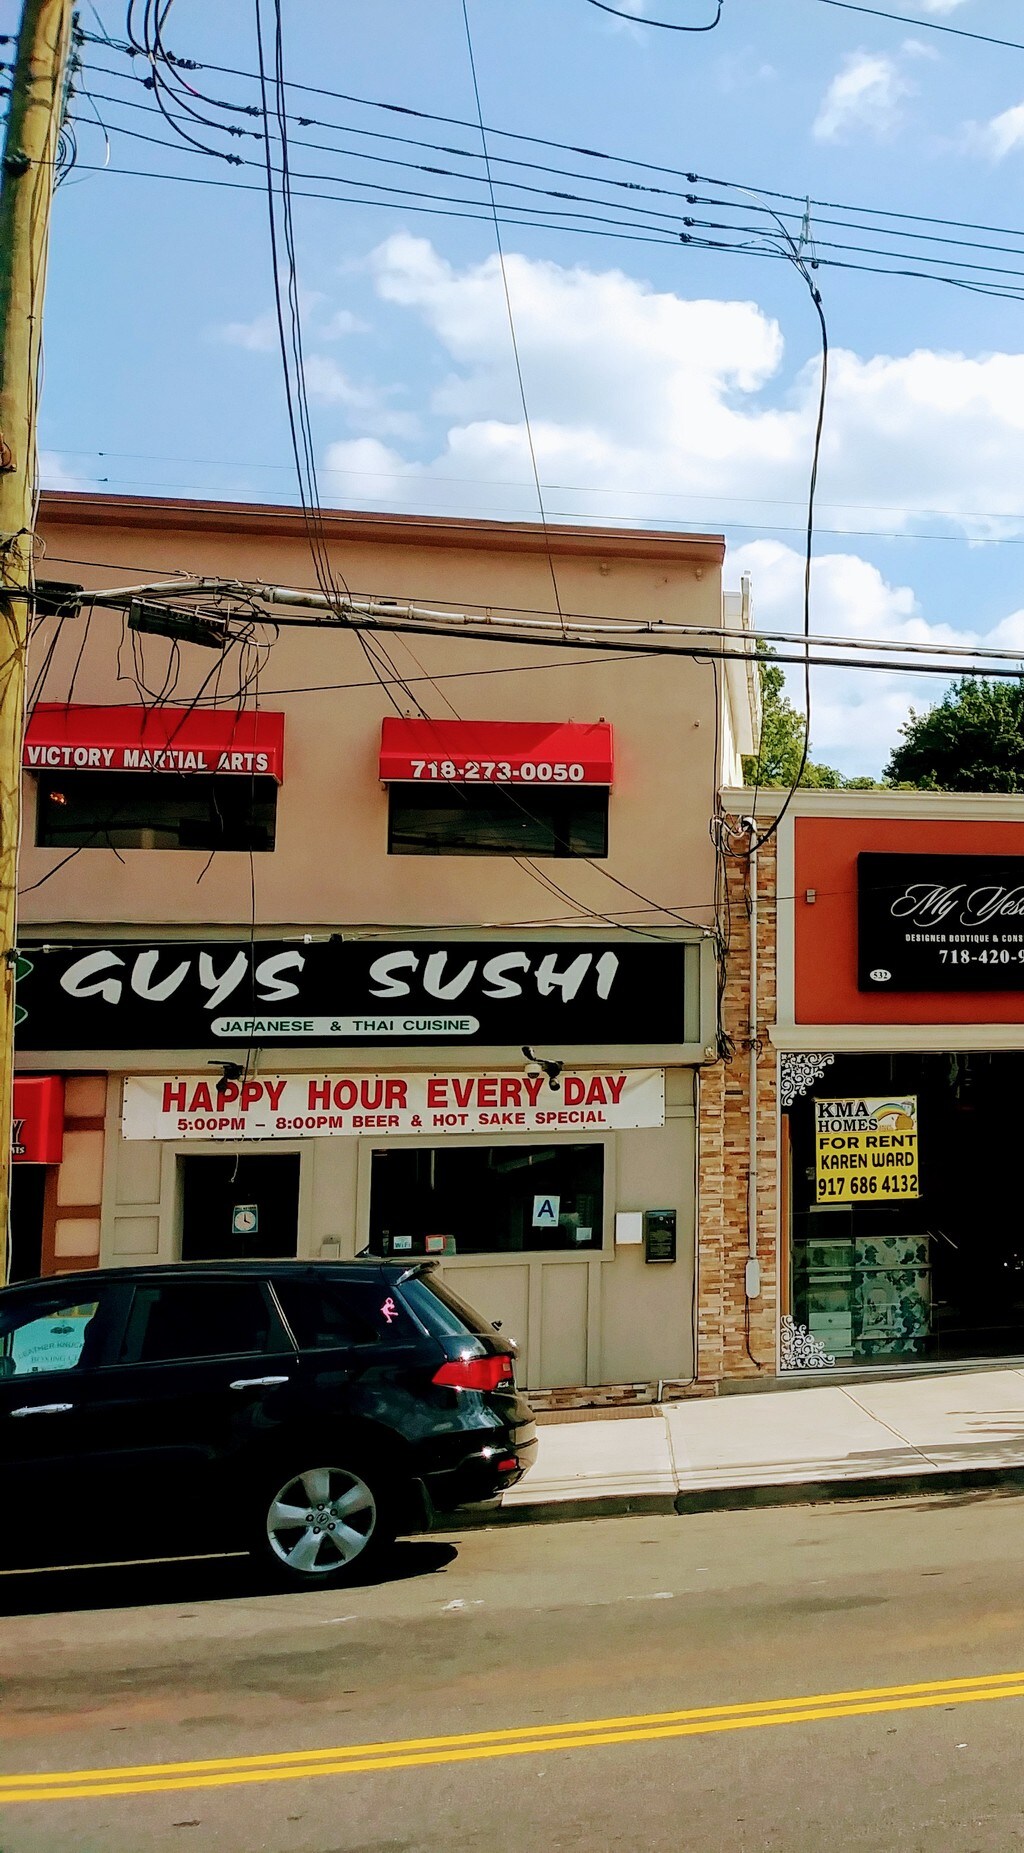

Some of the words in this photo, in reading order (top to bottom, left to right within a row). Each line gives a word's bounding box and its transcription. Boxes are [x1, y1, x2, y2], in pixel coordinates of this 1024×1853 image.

[27, 746, 115, 767] VICTORY
[124, 749, 207, 769] MARTIAL
[219, 752, 268, 771] ARTS
[411, 760, 584, 781] 718-273-0050
[891, 883, 967, 927] My
[905, 933, 946, 943] DESIGNER
[949, 933, 989, 943] BOUTIQUE
[992, 934, 999, 943] &
[59, 950, 305, 1010] GUYS
[368, 950, 619, 1003] SUSHI
[873, 971, 888, 980] 532
[220, 1020, 314, 1032] JAPANESE
[330, 1021, 342, 1031] &
[353, 1020, 394, 1031] THAI
[402, 1020, 470, 1031] CUISINE
[162, 1080, 288, 1113] HAPPY
[307, 1079, 408, 1111] HOUR
[427, 1077, 545, 1109] EVERY
[564, 1075, 627, 1106] DAY
[817, 1101, 870, 1118] KMA
[177, 1117, 246, 1131] 5:00PM
[275, 1115, 343, 1130] 8:00PM
[352, 1114, 400, 1128] BEER
[410, 1114, 423, 1127] &
[433, 1113, 469, 1126] HOT
[478, 1112, 526, 1125] SAKE
[535, 1110, 606, 1124] SPECIAL
[817, 1118, 878, 1133] HOMES
[819, 1136, 860, 1150] FOR
[865, 1134, 917, 1148] RENT
[821, 1153, 868, 1170] KAREN
[871, 1152, 915, 1168] WARD
[818, 1177, 845, 1196] 917
[850, 1176, 877, 1194] 686
[881, 1174, 918, 1193] 4132
[537, 1199, 555, 1218] A
